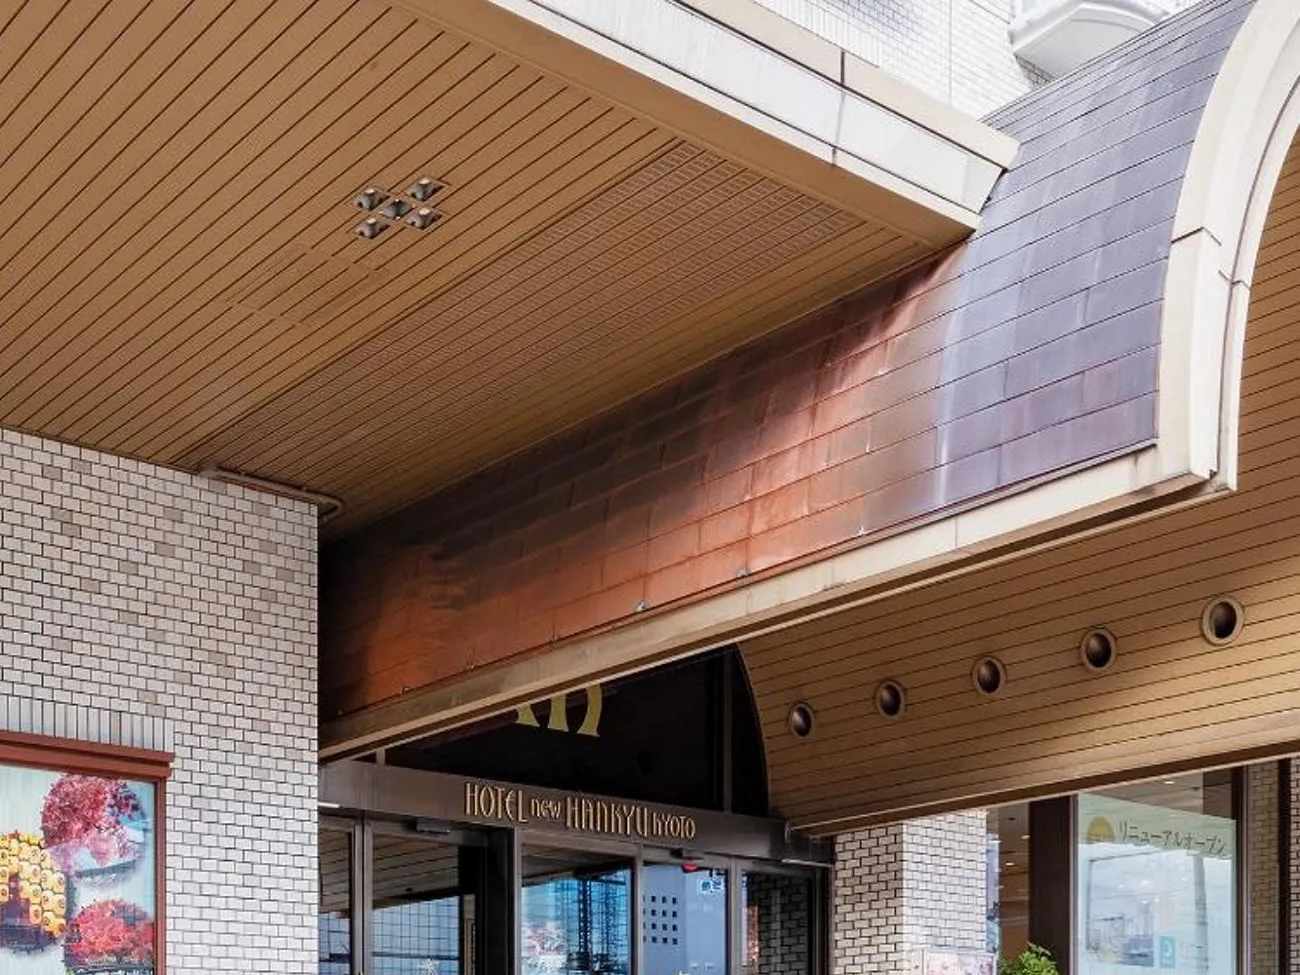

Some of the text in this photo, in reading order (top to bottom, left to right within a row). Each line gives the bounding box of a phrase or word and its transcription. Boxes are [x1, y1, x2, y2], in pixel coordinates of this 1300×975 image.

[465, 782, 529, 823] HOTEL
[531, 797, 561, 819] new
[565, 796, 649, 838] HANKYU
[1117, 817, 1230, 859] リニューアルオープン
